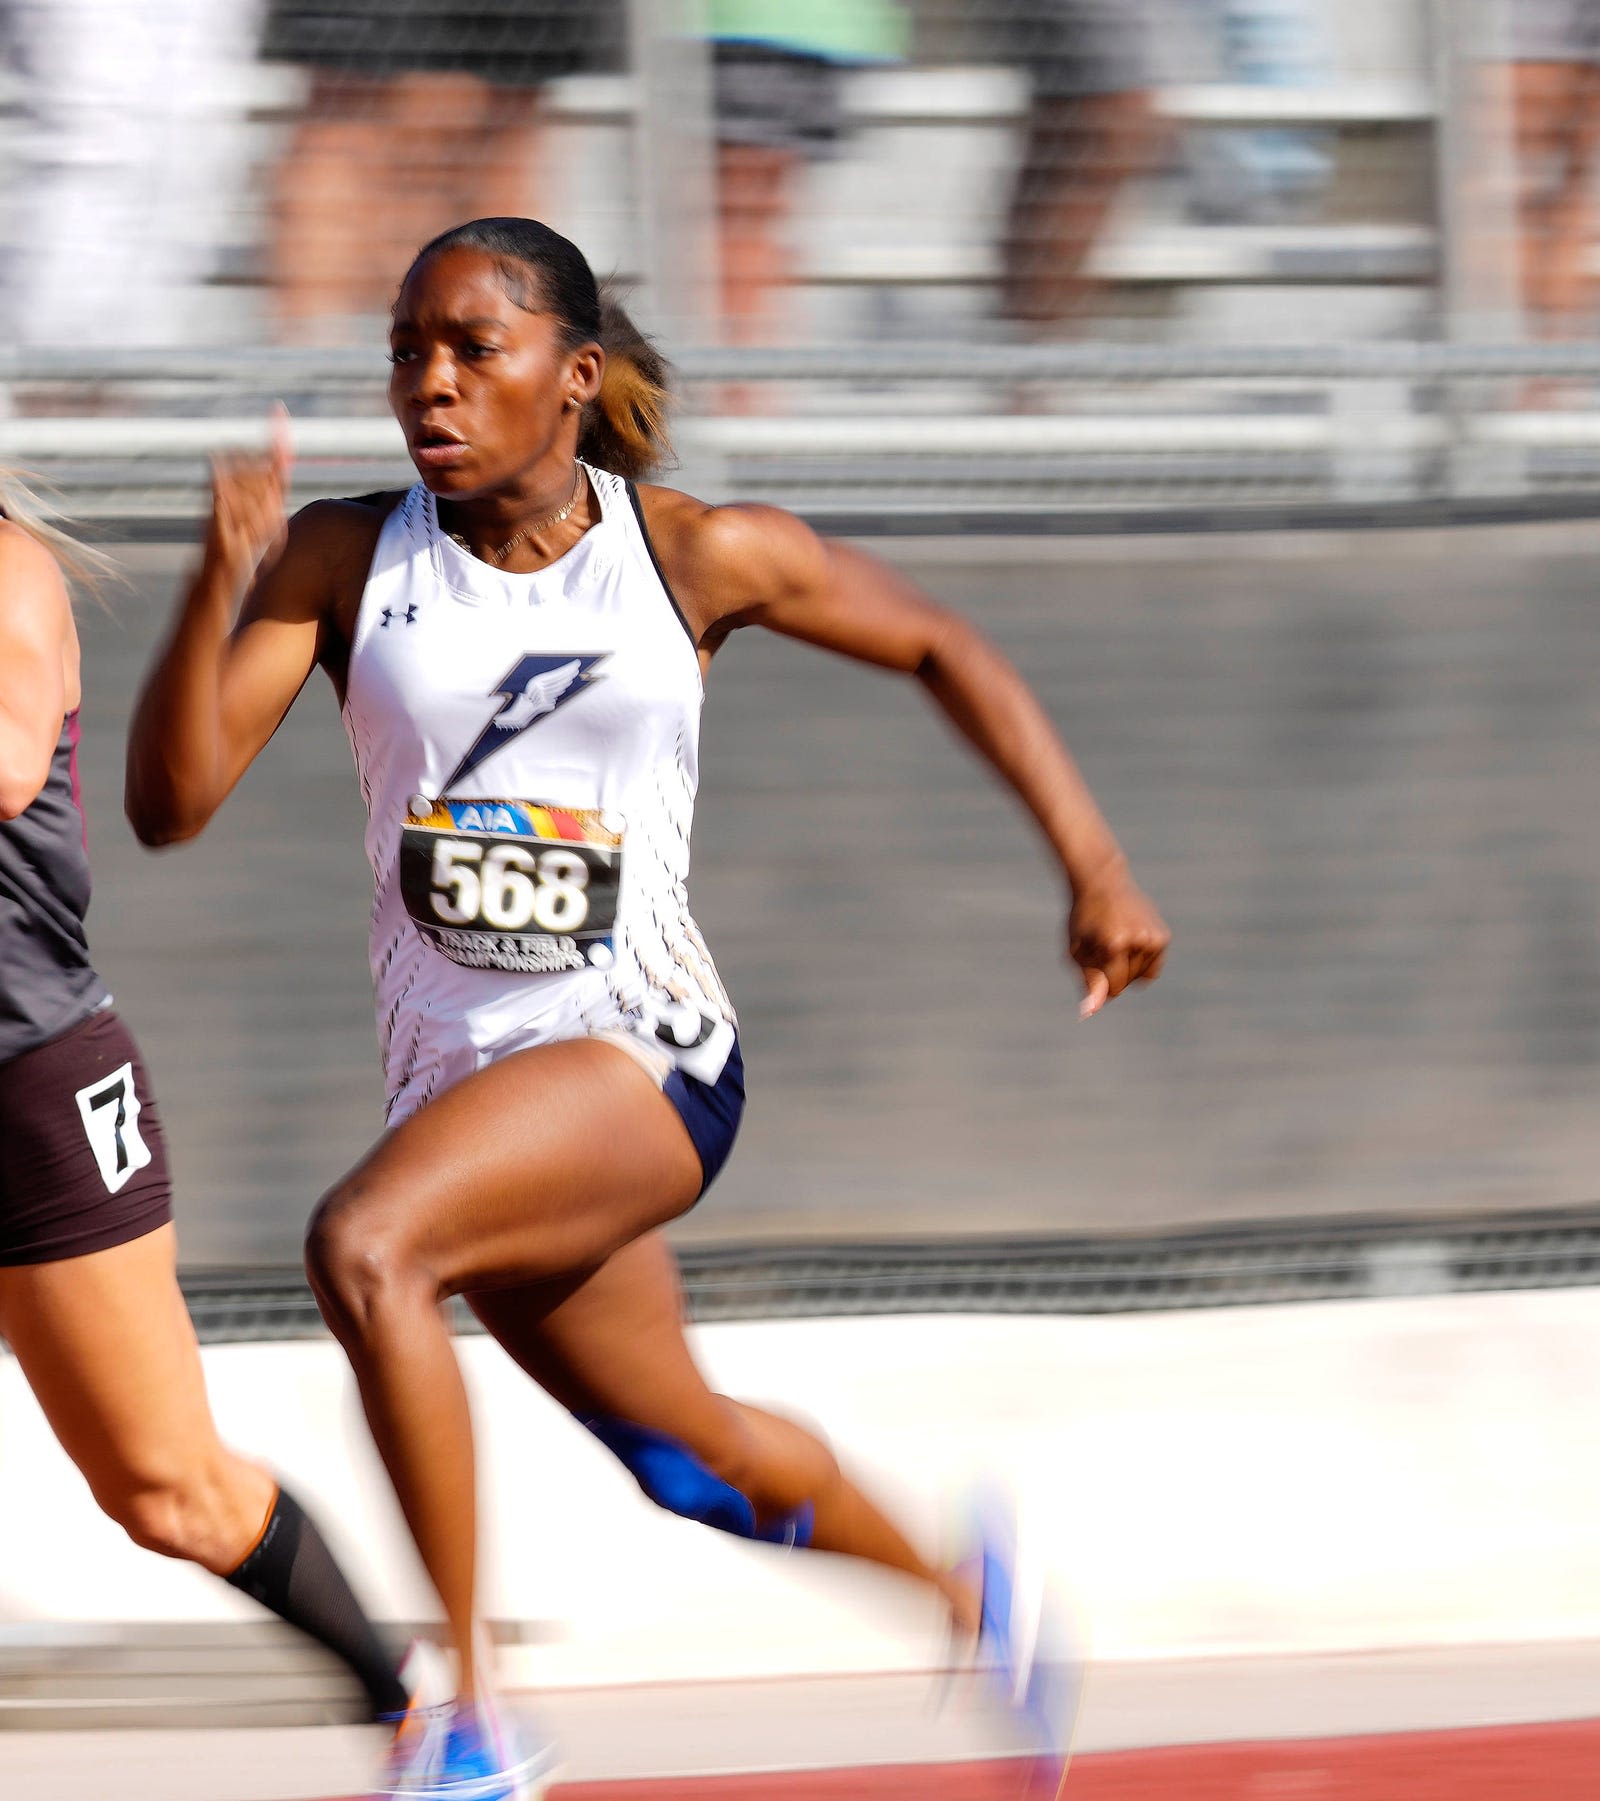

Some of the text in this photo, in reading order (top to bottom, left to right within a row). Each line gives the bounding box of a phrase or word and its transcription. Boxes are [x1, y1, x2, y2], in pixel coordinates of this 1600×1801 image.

[457, 804, 519, 833] AIA
[429, 837, 590, 933] 568
[88, 1077, 129, 1175] 7
